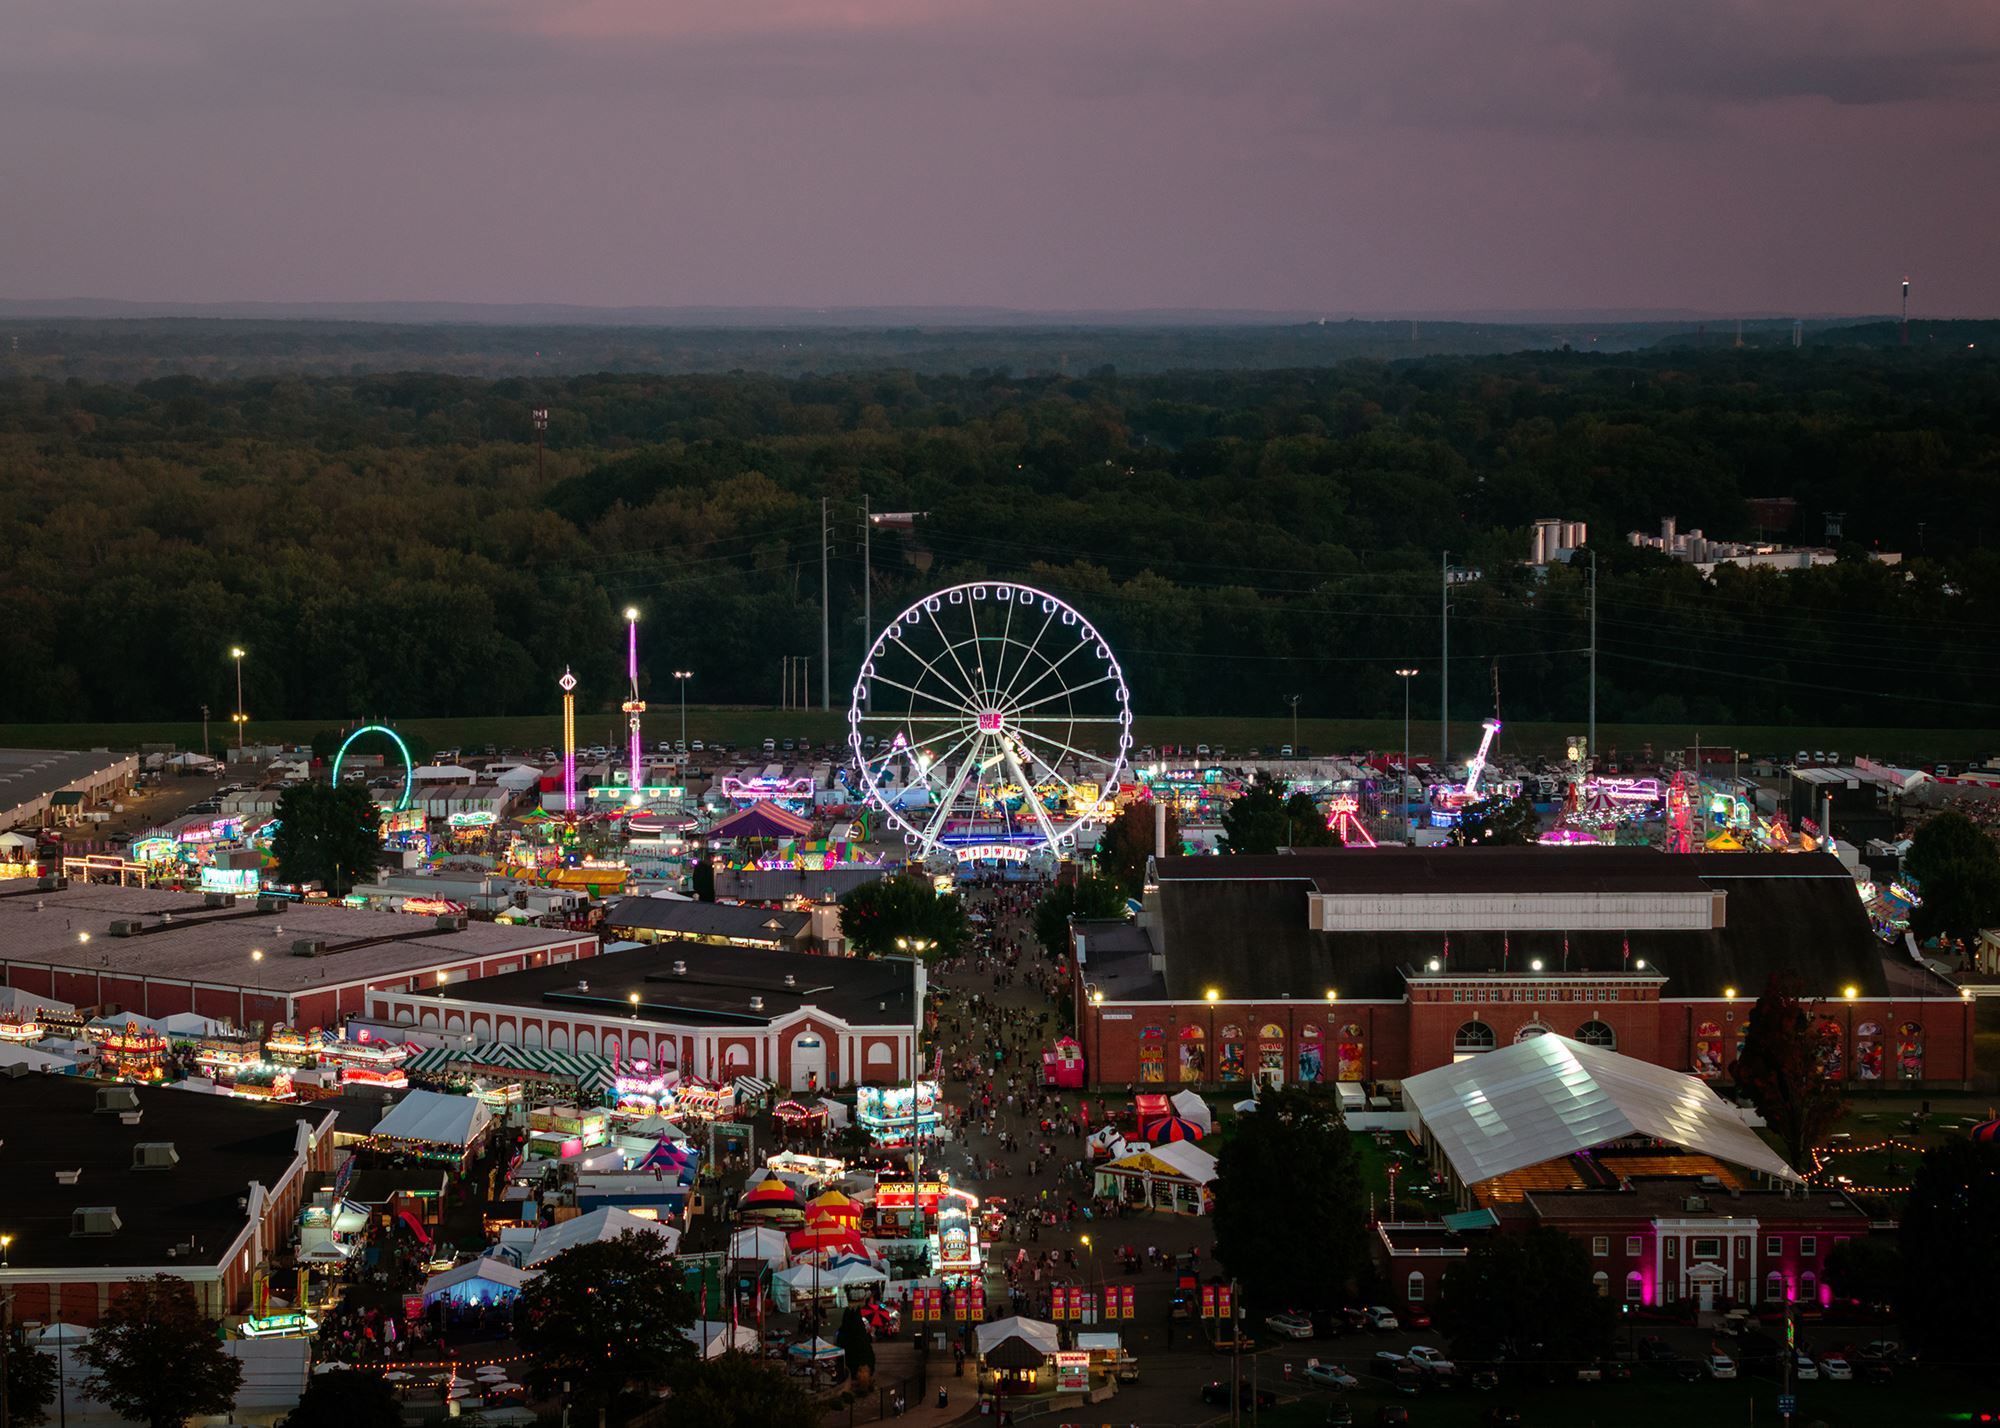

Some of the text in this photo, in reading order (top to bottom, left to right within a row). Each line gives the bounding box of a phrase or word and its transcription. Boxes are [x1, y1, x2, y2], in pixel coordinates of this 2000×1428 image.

[980, 713, 1001, 729] BIG E
[958, 848, 1026, 859] MIDWAY
[944, 1232, 967, 1241] FUNNEL
[946, 1242, 966, 1250] CAKES
